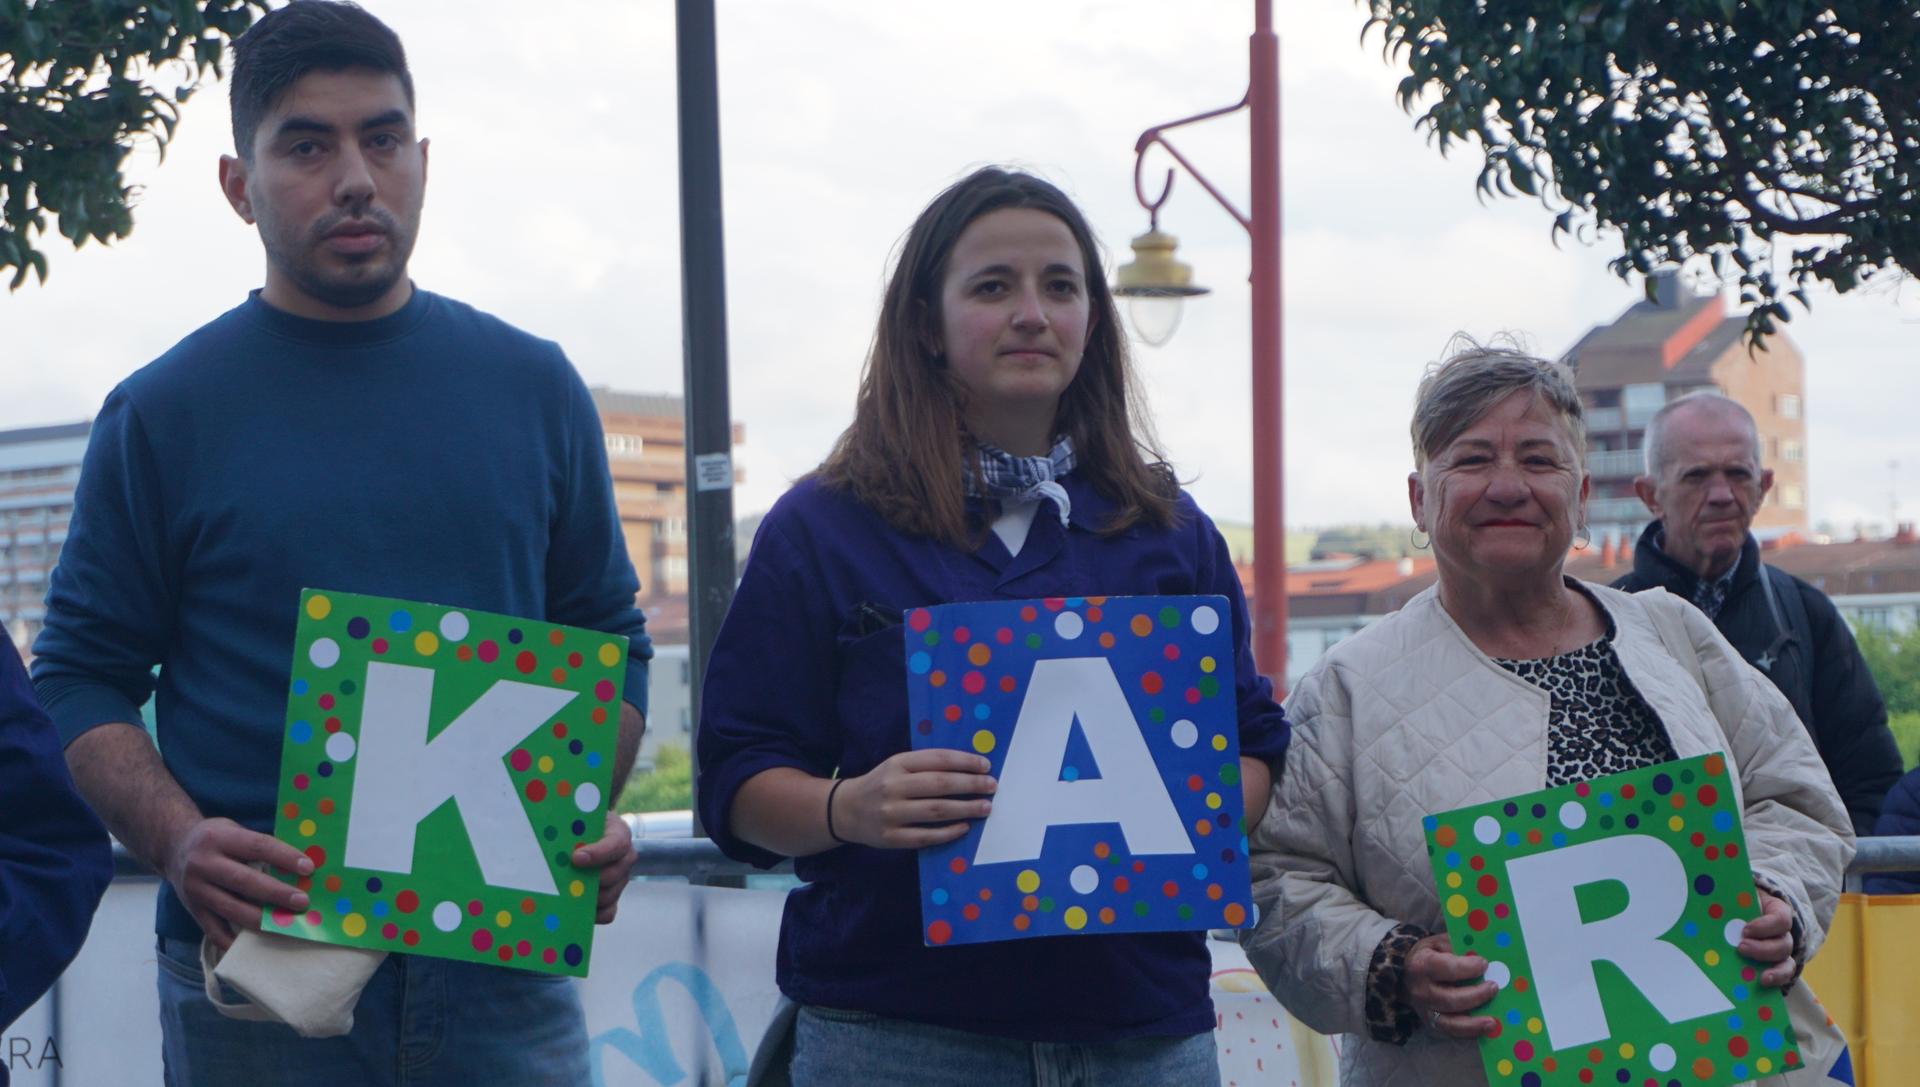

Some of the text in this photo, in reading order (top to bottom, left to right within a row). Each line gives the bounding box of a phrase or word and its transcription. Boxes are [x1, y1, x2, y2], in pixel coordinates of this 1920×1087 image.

[344, 661, 581, 895] K
[973, 657, 1196, 866] A
[1505, 834, 1736, 1051] R
